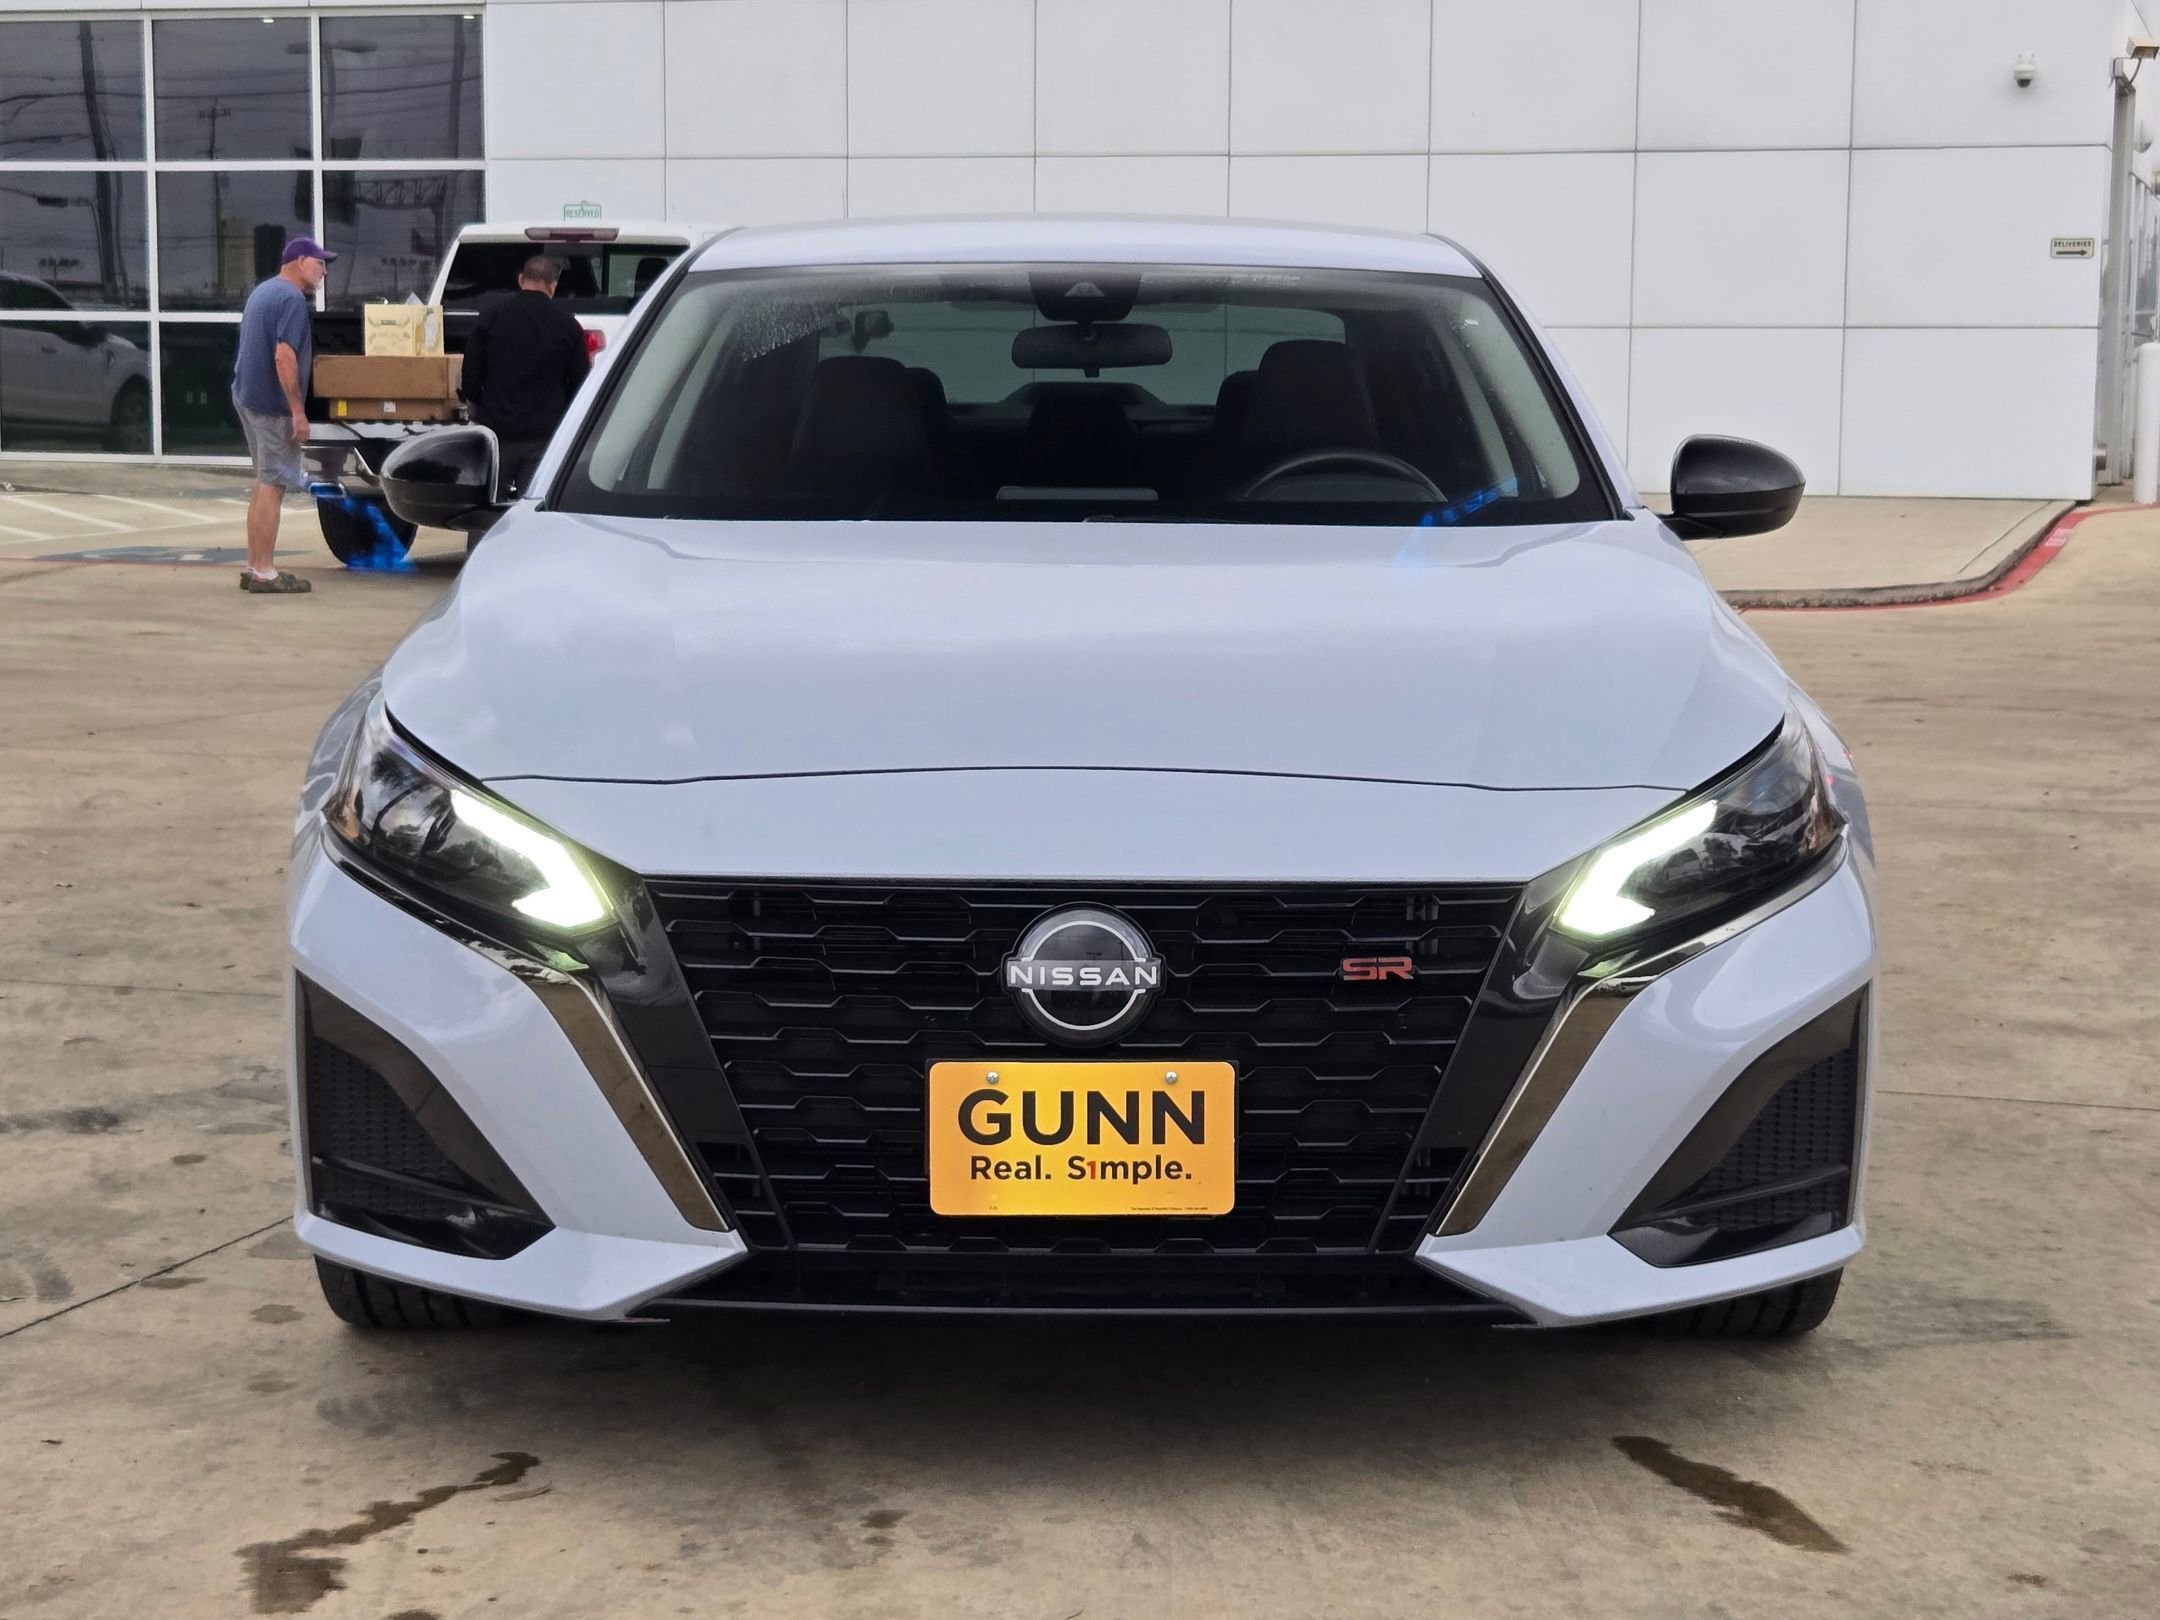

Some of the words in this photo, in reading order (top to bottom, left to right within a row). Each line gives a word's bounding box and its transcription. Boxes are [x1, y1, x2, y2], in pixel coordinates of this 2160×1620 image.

[2053, 240, 2092, 248] DELIVERIES
[1010, 964, 1157, 986] NISSAN
[1342, 956, 1414, 981] SR
[957, 1088, 1205, 1146] GUNN
[970, 1154, 1052, 1181] Real.
